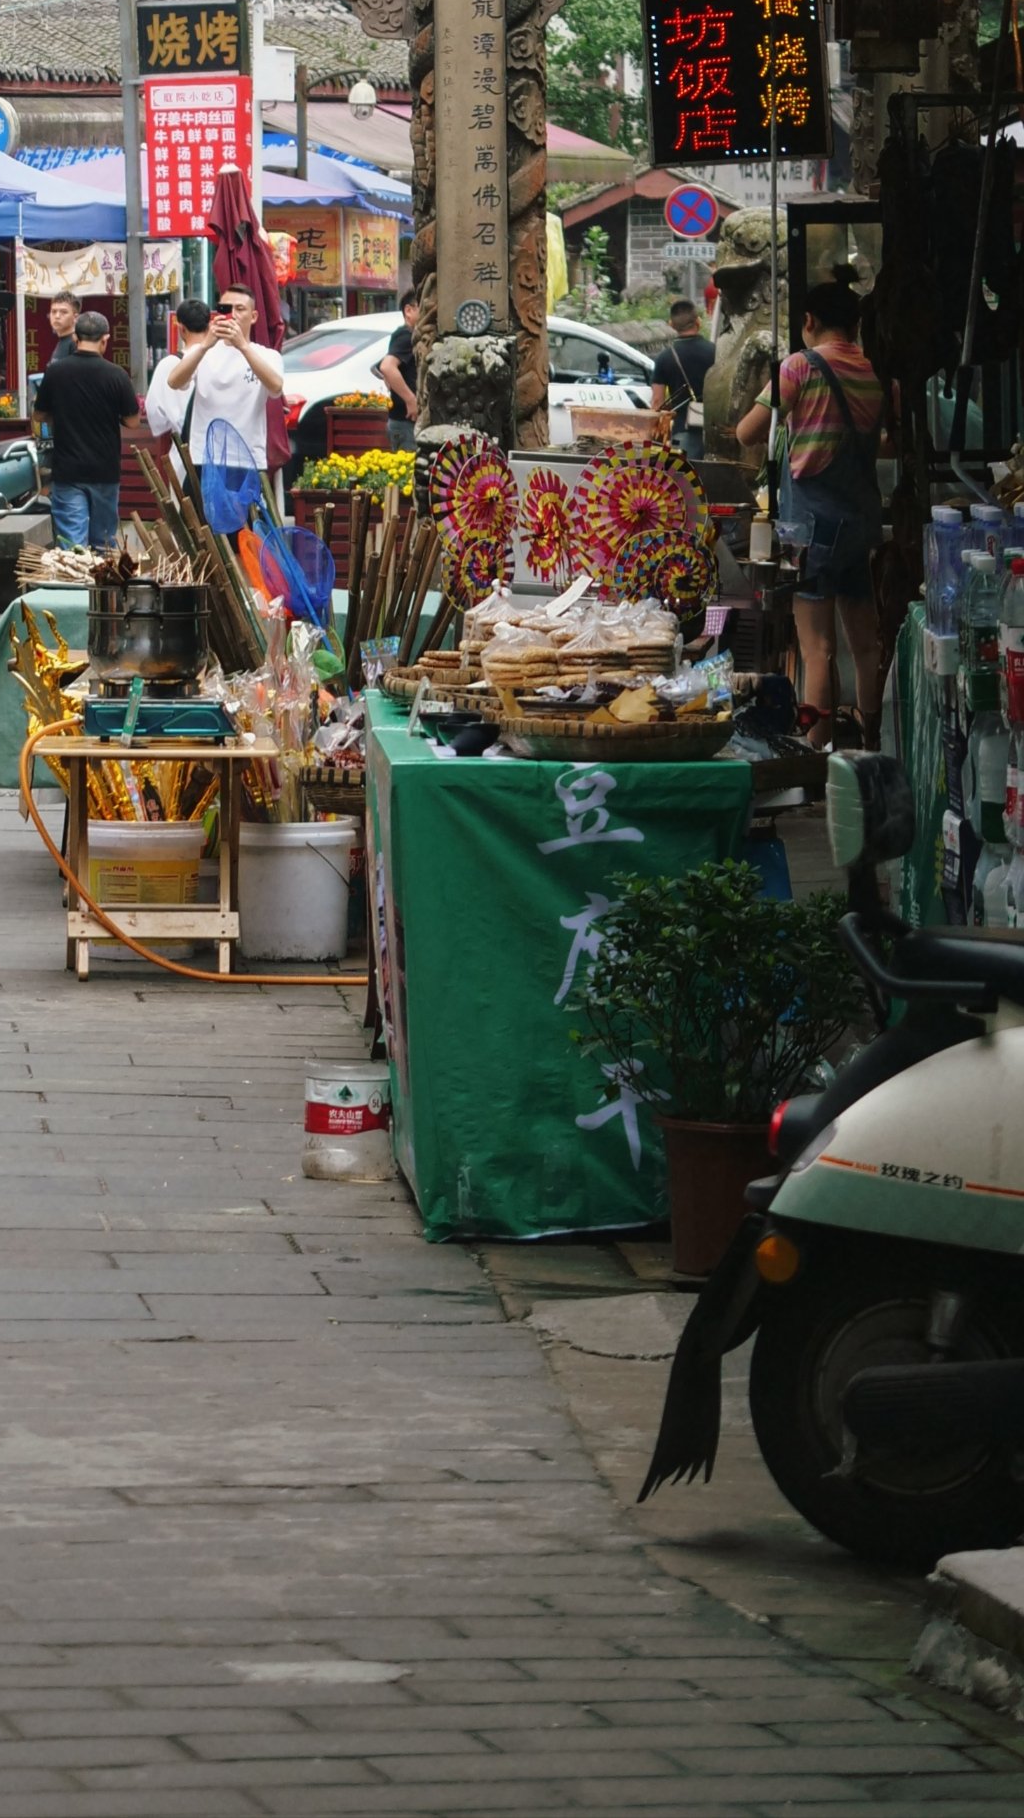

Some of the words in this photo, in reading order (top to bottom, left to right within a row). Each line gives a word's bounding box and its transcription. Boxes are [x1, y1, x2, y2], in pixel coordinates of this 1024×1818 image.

[146, 10, 240, 67] 烧烤
[155, 163, 235, 179] 炸酱米
[880, 1162, 964, 1190] 玫瑰之约
